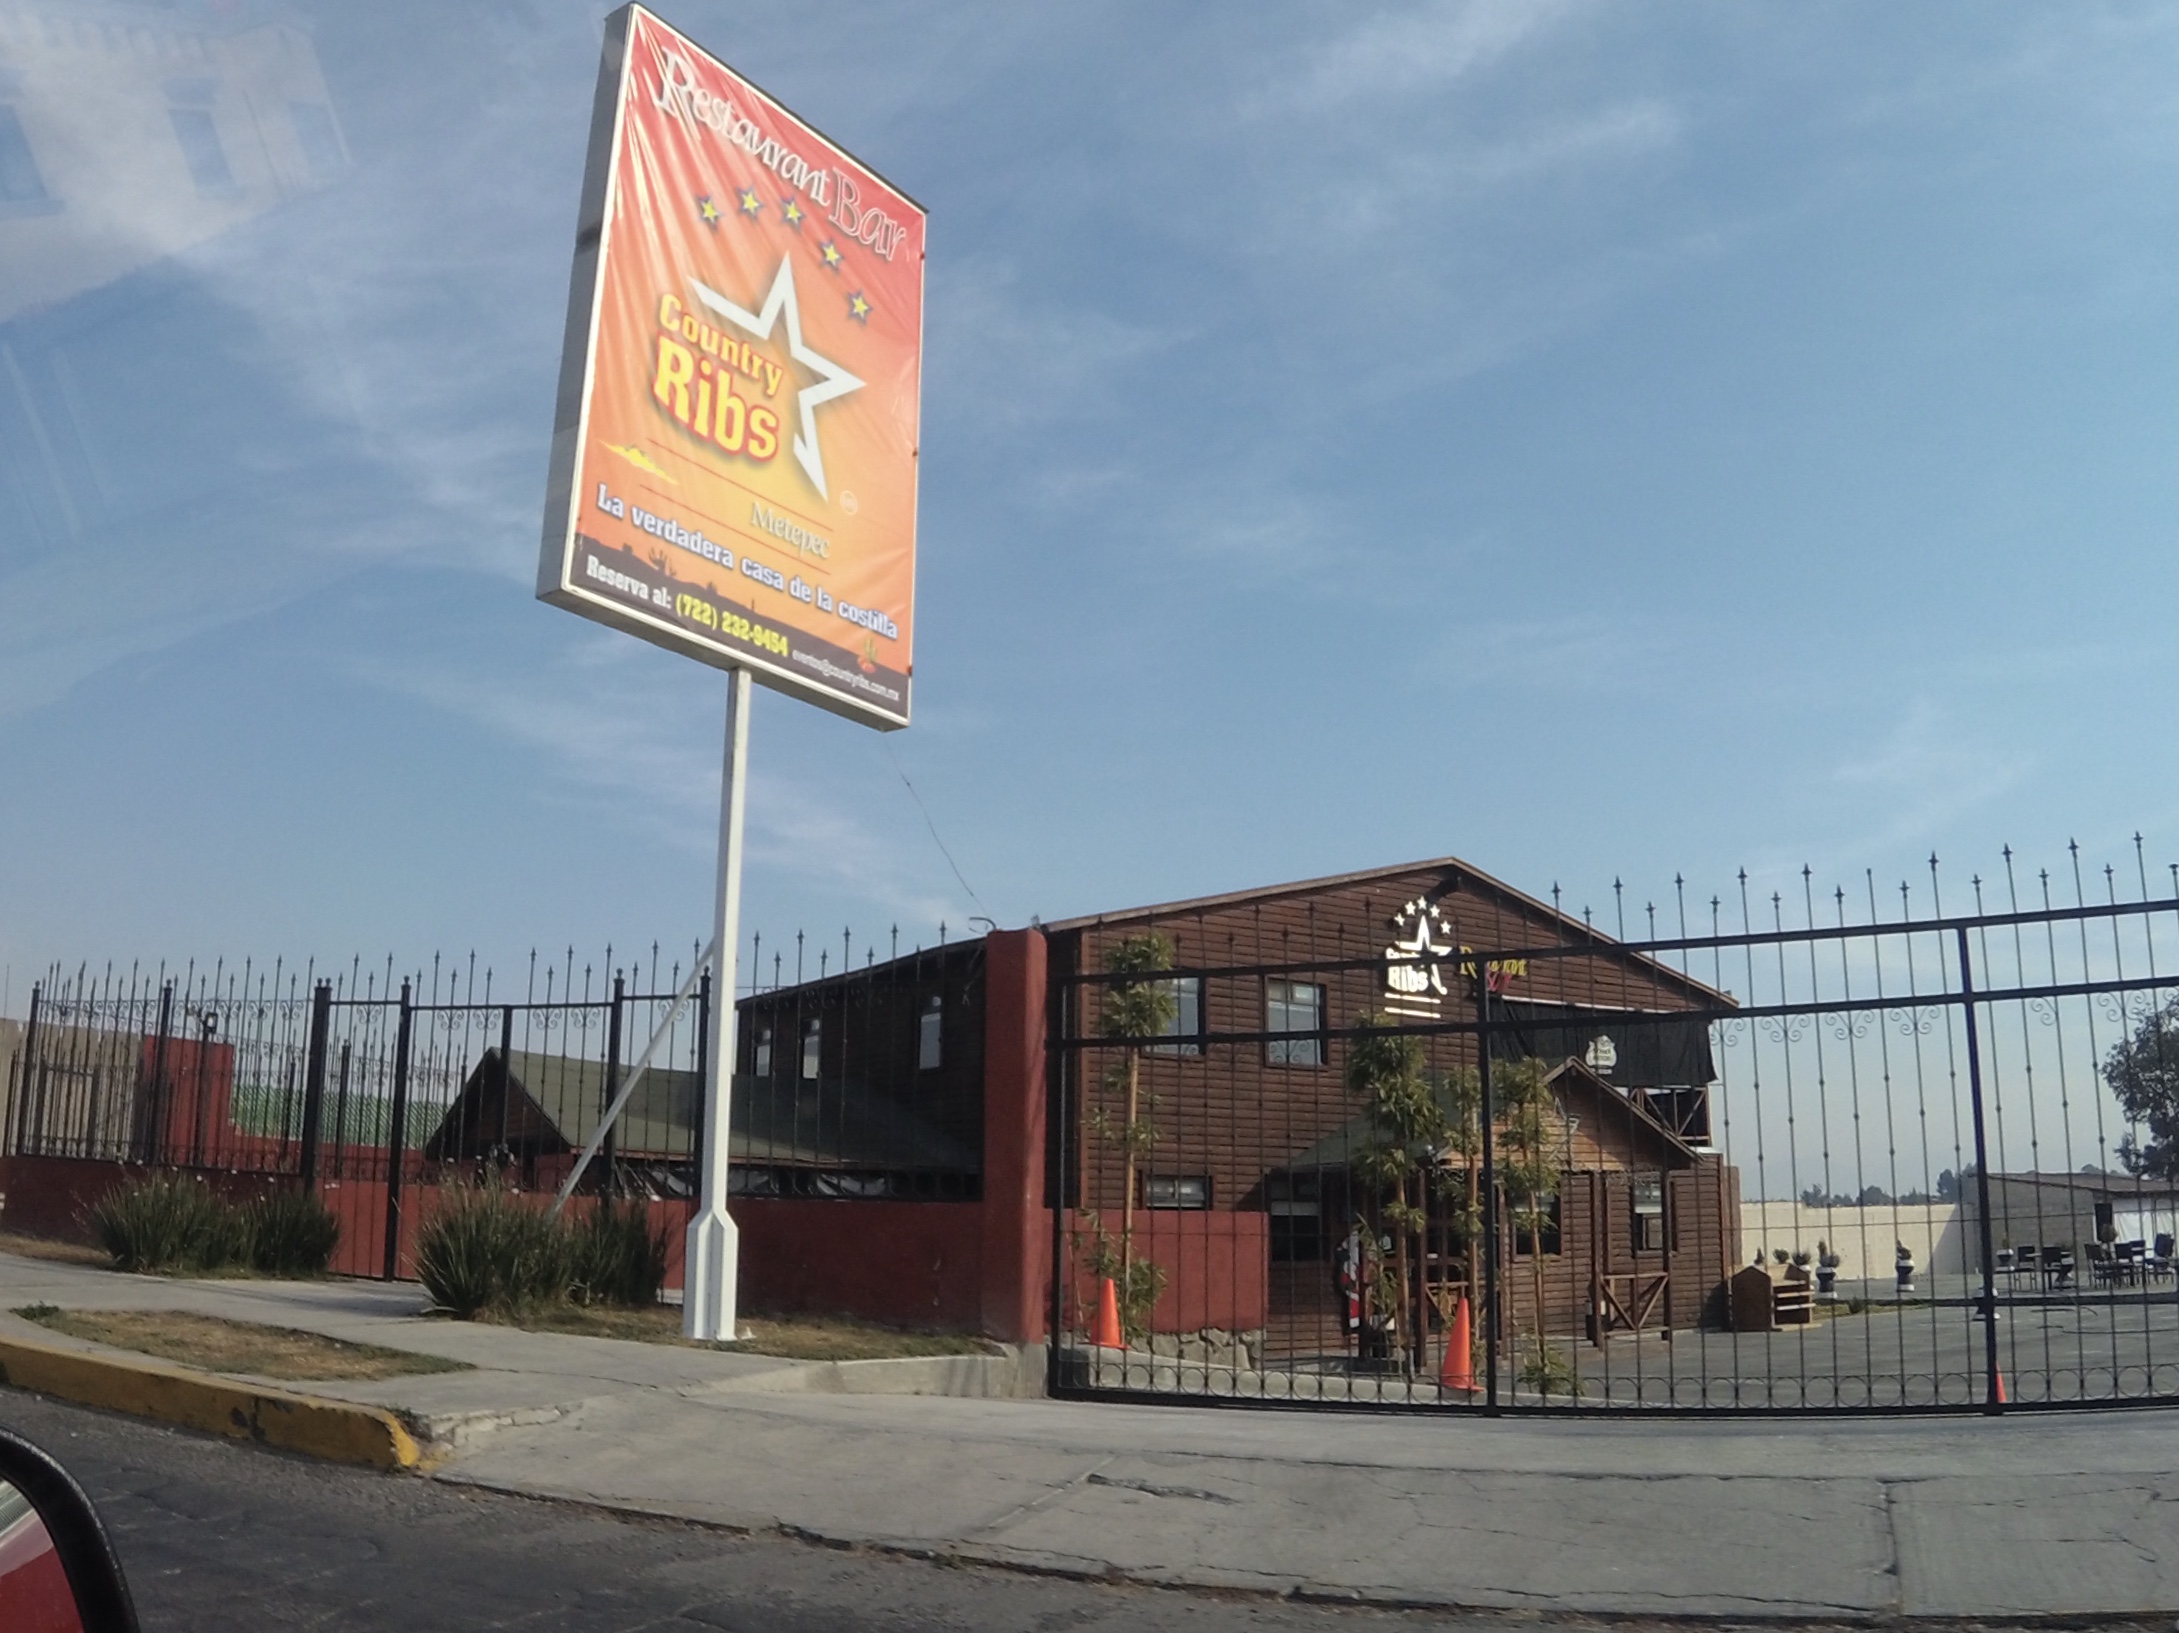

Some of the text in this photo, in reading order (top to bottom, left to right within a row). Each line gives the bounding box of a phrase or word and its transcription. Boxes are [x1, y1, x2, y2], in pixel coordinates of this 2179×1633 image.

[657, 46, 907, 262] Restaurant Bar
[652, 332, 780, 462] Ribs
[659, 293, 784, 398] Country
[597, 483, 898, 640] La verdadera casa de la costilla
[751, 502, 831, 558] Metepec
[586, 555, 649, 601] Reserva
[652, 586, 672, 609] al:
[676, 593, 717, 631] (722)
[1388, 965, 1429, 992] Ribs
